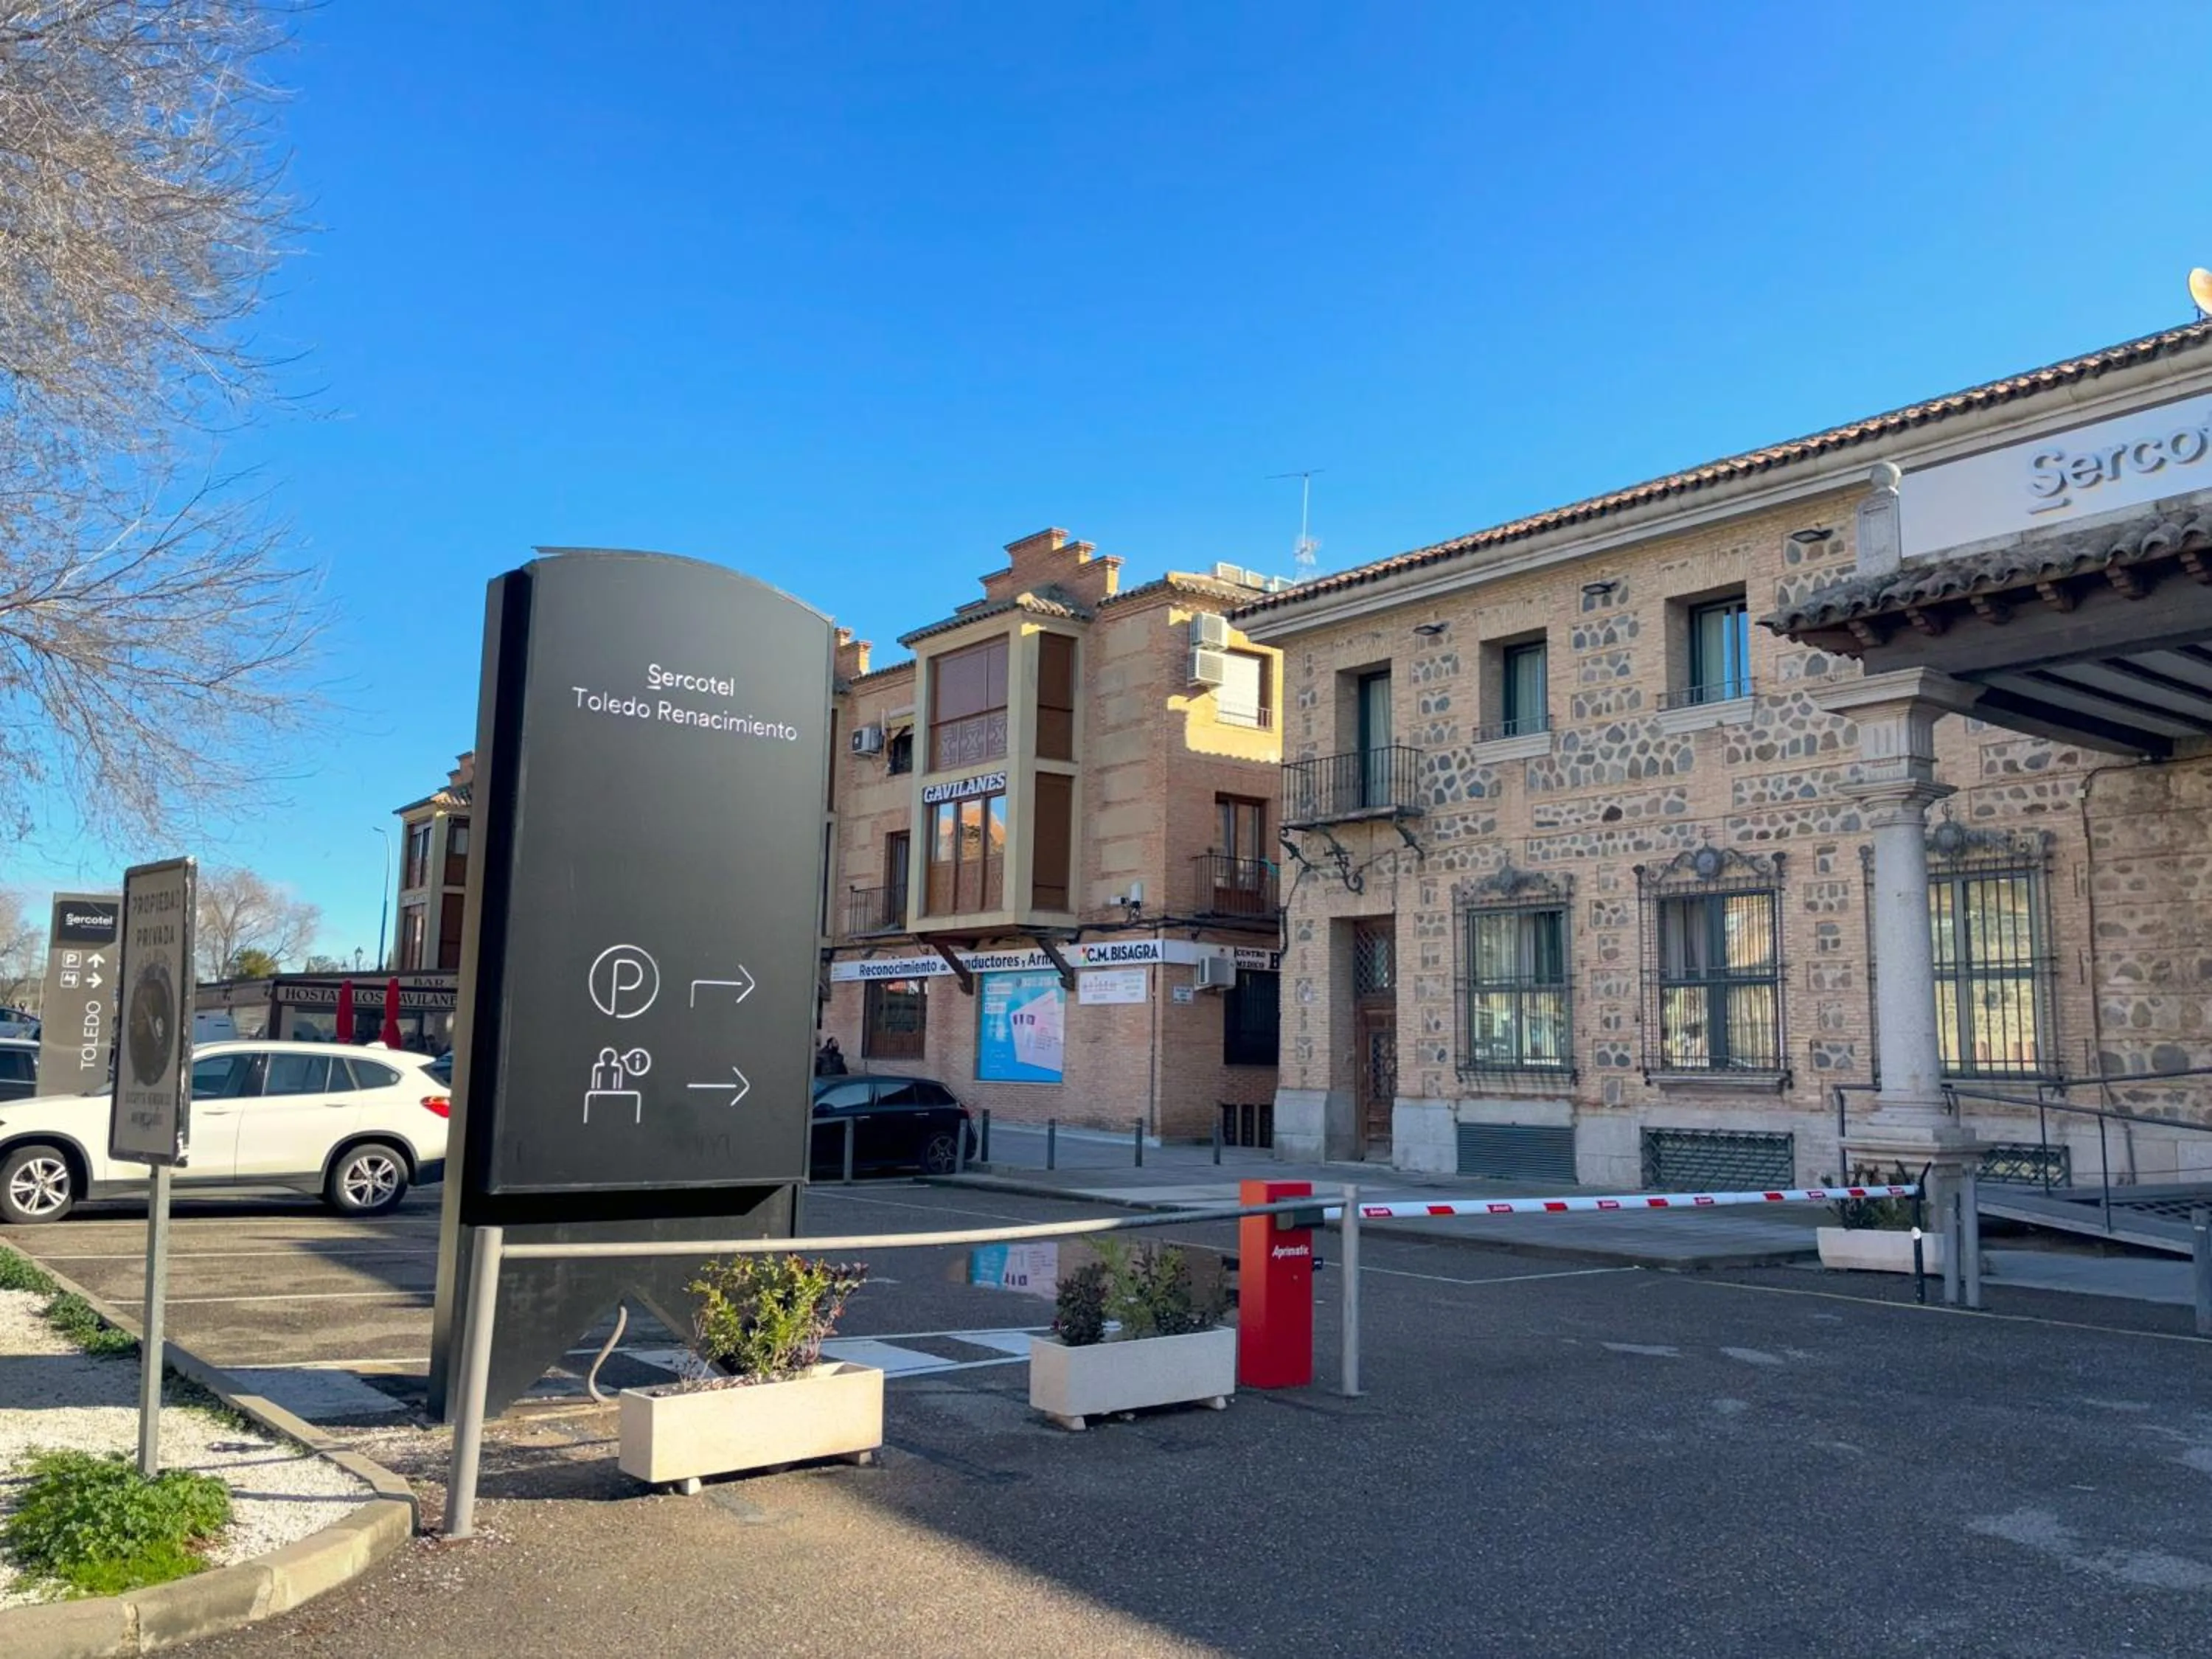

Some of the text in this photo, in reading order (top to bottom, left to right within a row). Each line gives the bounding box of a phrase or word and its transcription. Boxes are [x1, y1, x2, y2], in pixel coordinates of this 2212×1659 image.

[647, 663, 735, 697] Sercotel
[571, 686, 798, 742] Toledo Renacimiento
[924, 771, 1006, 803] GAVILANES
[132, 888, 180, 915] PROPIEDAD
[66, 912, 114, 925] Sercotel
[136, 925, 175, 948] PRIVADA
[1111, 943, 1159, 961] BISAGRA
[1237, 949, 1266, 958] CENTRO
[859, 959, 938, 976] Reconocimiento
[964, 955, 1020, 969] nductores
[414, 978, 445, 987] BAR
[285, 987, 342, 1001] HOSTA
[400, 993, 458, 1006] AVILANE
[80, 1000, 101, 1071] TOLEDO
